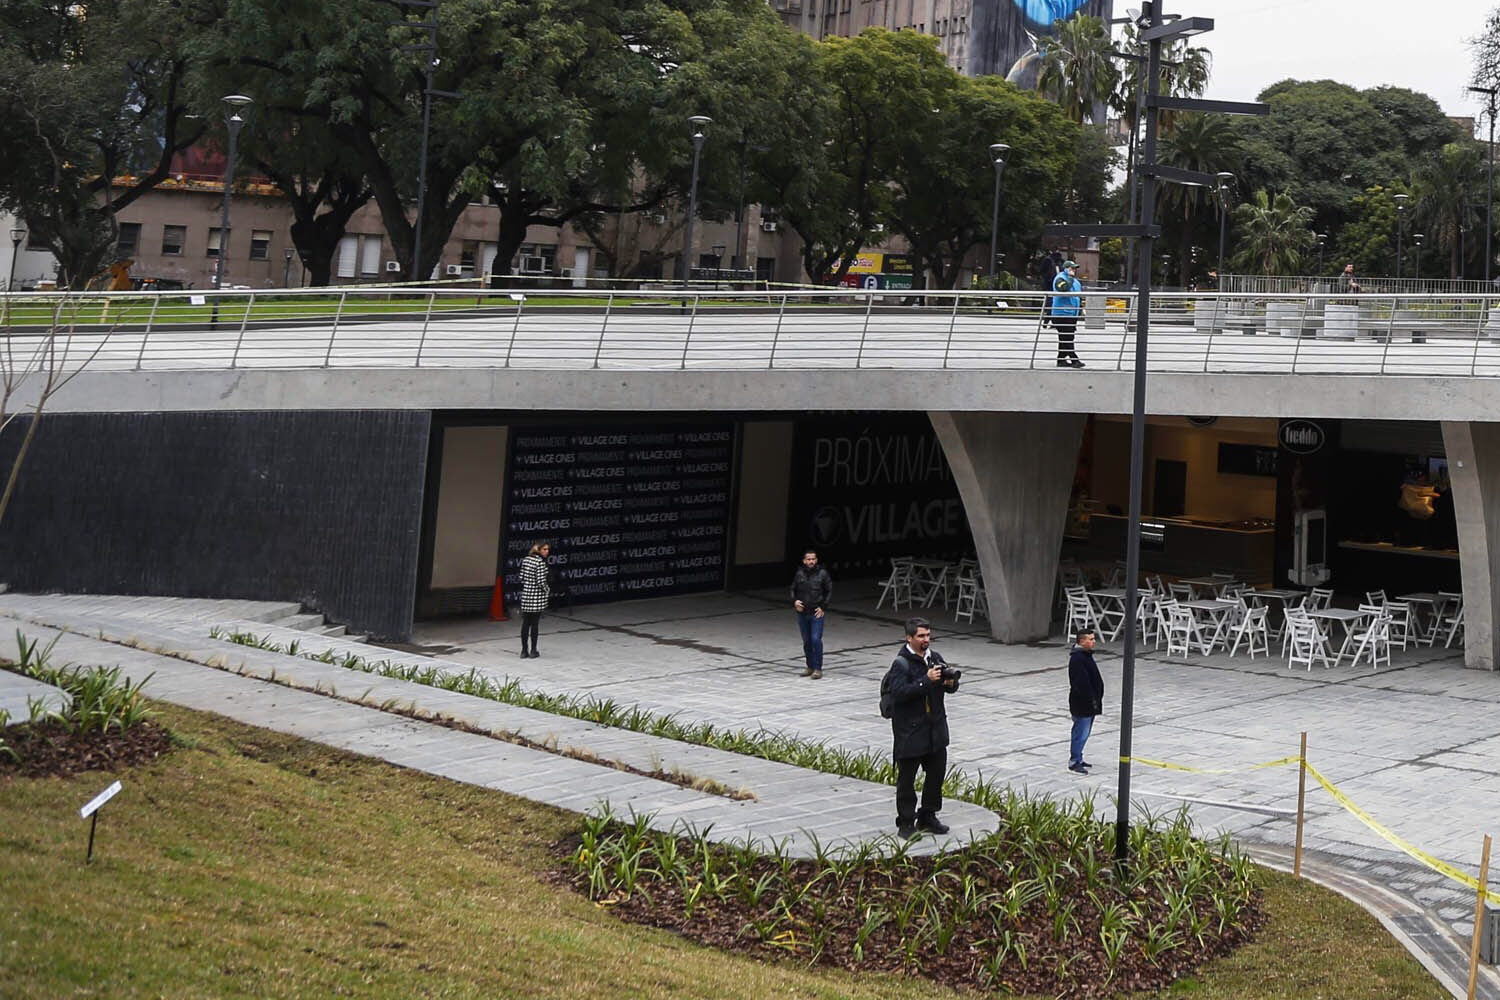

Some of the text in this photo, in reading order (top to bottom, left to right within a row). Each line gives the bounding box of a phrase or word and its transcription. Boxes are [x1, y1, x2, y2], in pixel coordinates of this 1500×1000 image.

[578, 436, 608, 446] VILLAGE
[1285, 426, 1318, 446] freddo
[523, 454, 555, 465] VILLAGE
[812, 426, 954, 488] PRÓXIMA
[576, 468, 605, 478] VILLAGE
[520, 487, 552, 498] VILLAGE
[573, 500, 602, 510] VILLAGE
[519, 520, 549, 531] VILLAGE
[844, 497, 961, 545] VILLAGE
[570, 535, 600, 545] VILLAGE
[568, 567, 598, 579] VILLAGE
